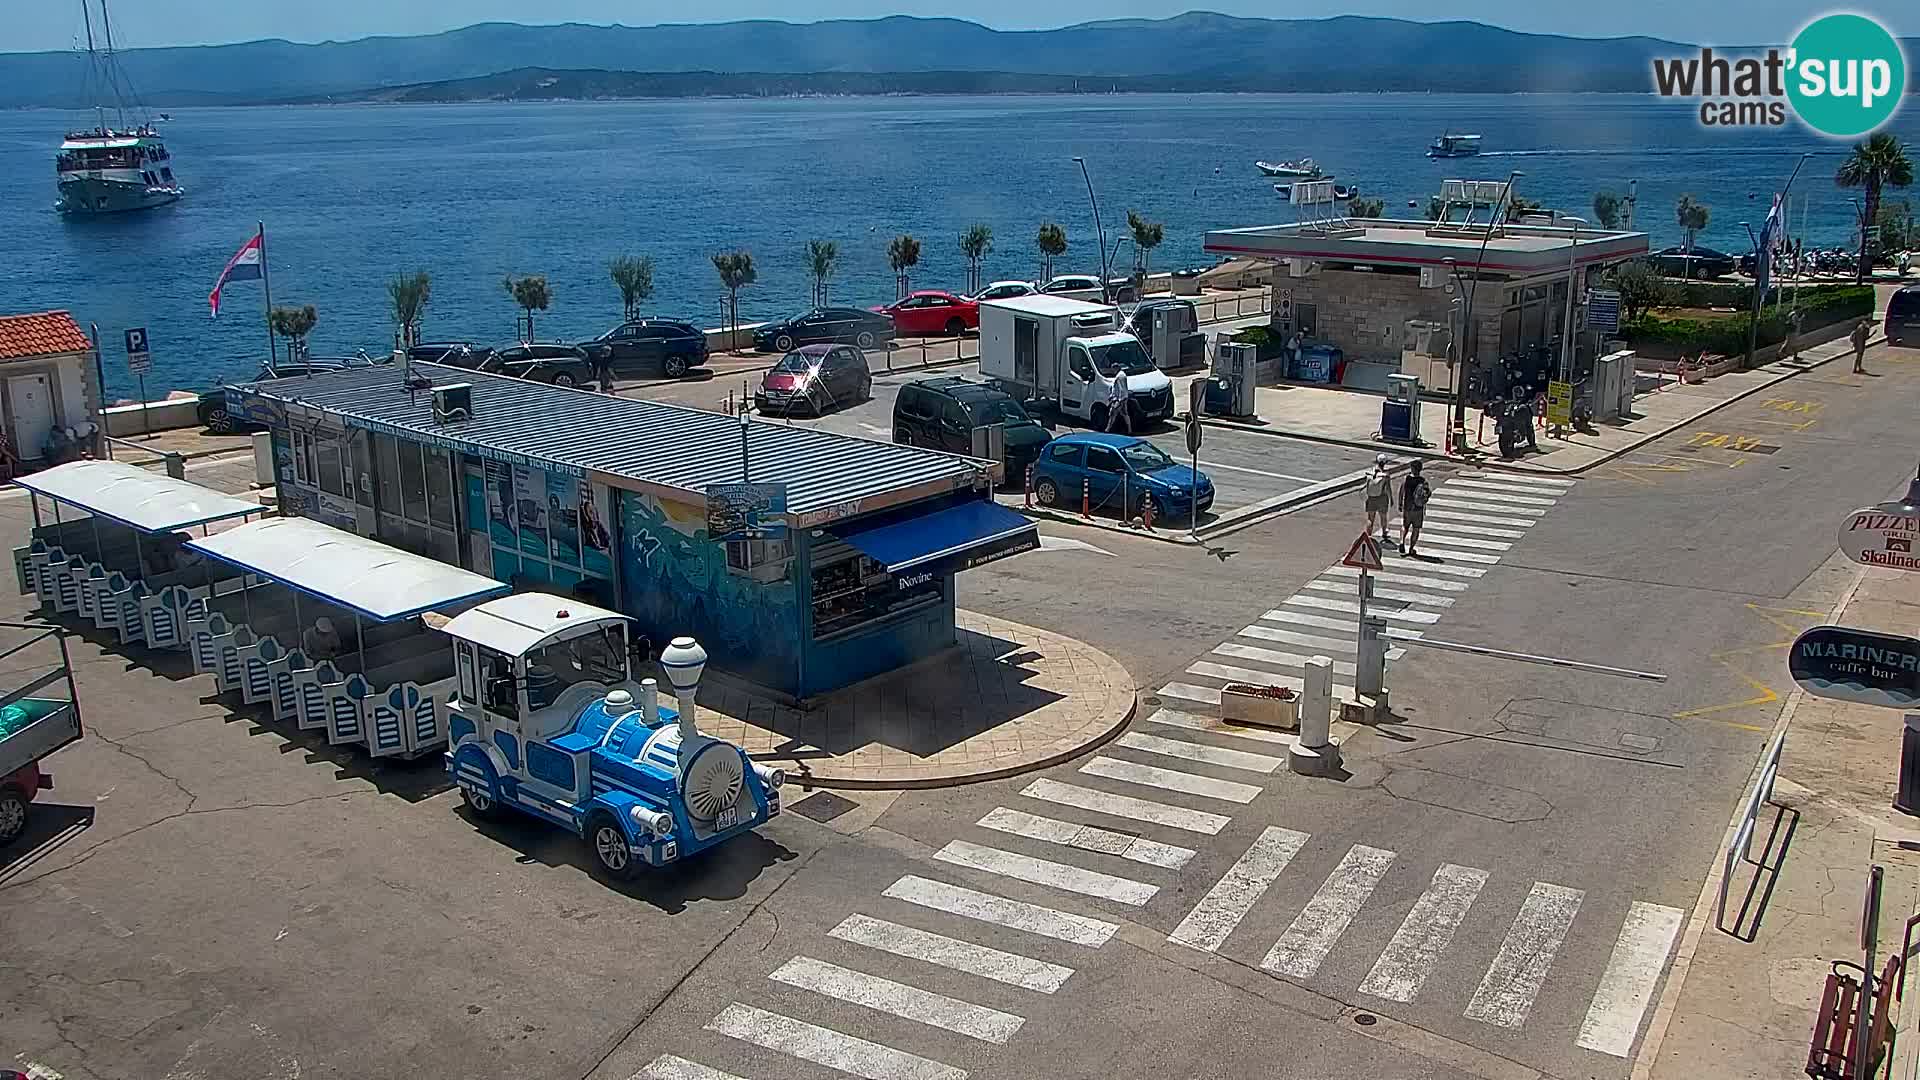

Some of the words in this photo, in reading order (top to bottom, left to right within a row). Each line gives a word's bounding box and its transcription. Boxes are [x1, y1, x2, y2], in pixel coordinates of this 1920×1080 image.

[1688, 431, 1760, 451] TAXI
[478, 446, 492, 458] BUS
[494, 449, 526, 465] STATION
[528, 457, 553, 471] TICKET
[555, 463, 582, 477] OFFICE
[1830, 663, 1867, 673] caffe
[1871, 666, 1898, 679] bar
